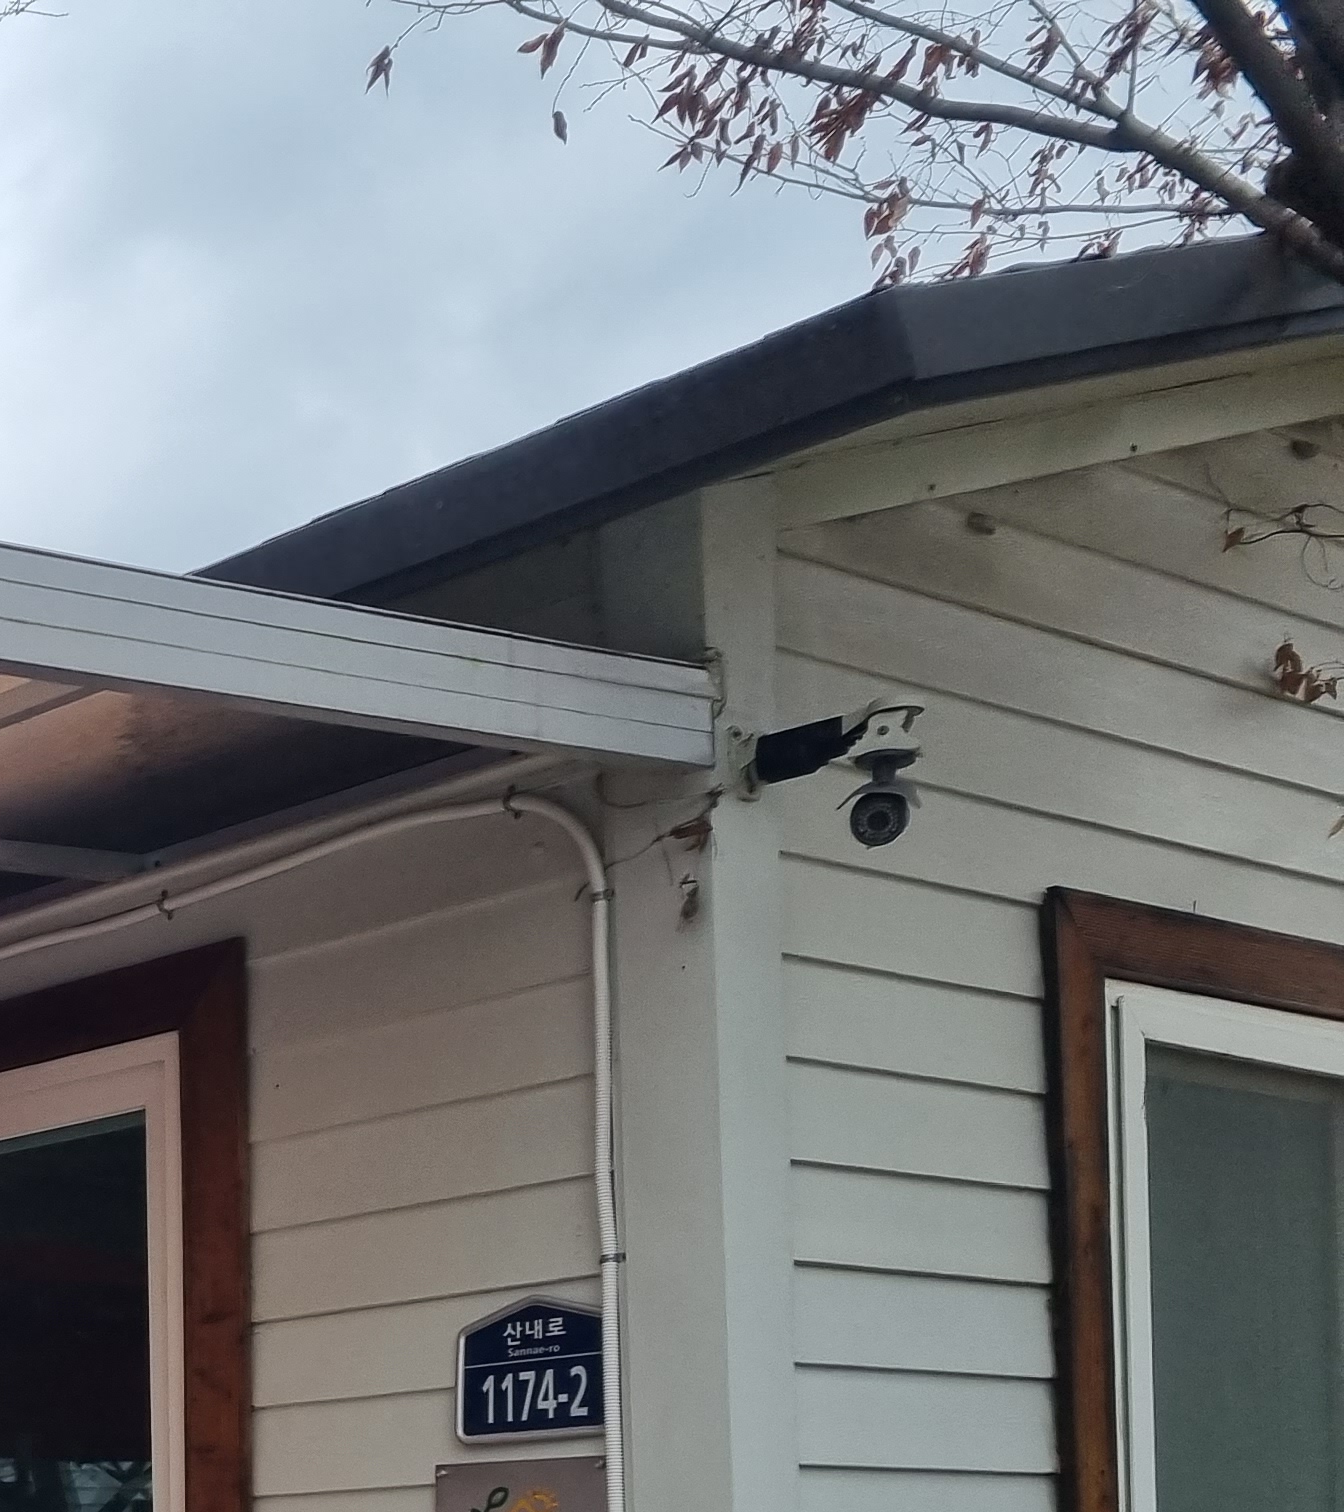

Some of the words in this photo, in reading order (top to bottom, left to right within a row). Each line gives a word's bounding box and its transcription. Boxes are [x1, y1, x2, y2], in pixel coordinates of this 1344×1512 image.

[502, 1317, 567, 1346] 산내로
[507, 1345, 561, 1358] Sannae-ro
[482, 1365, 589, 1424] 1174-2
